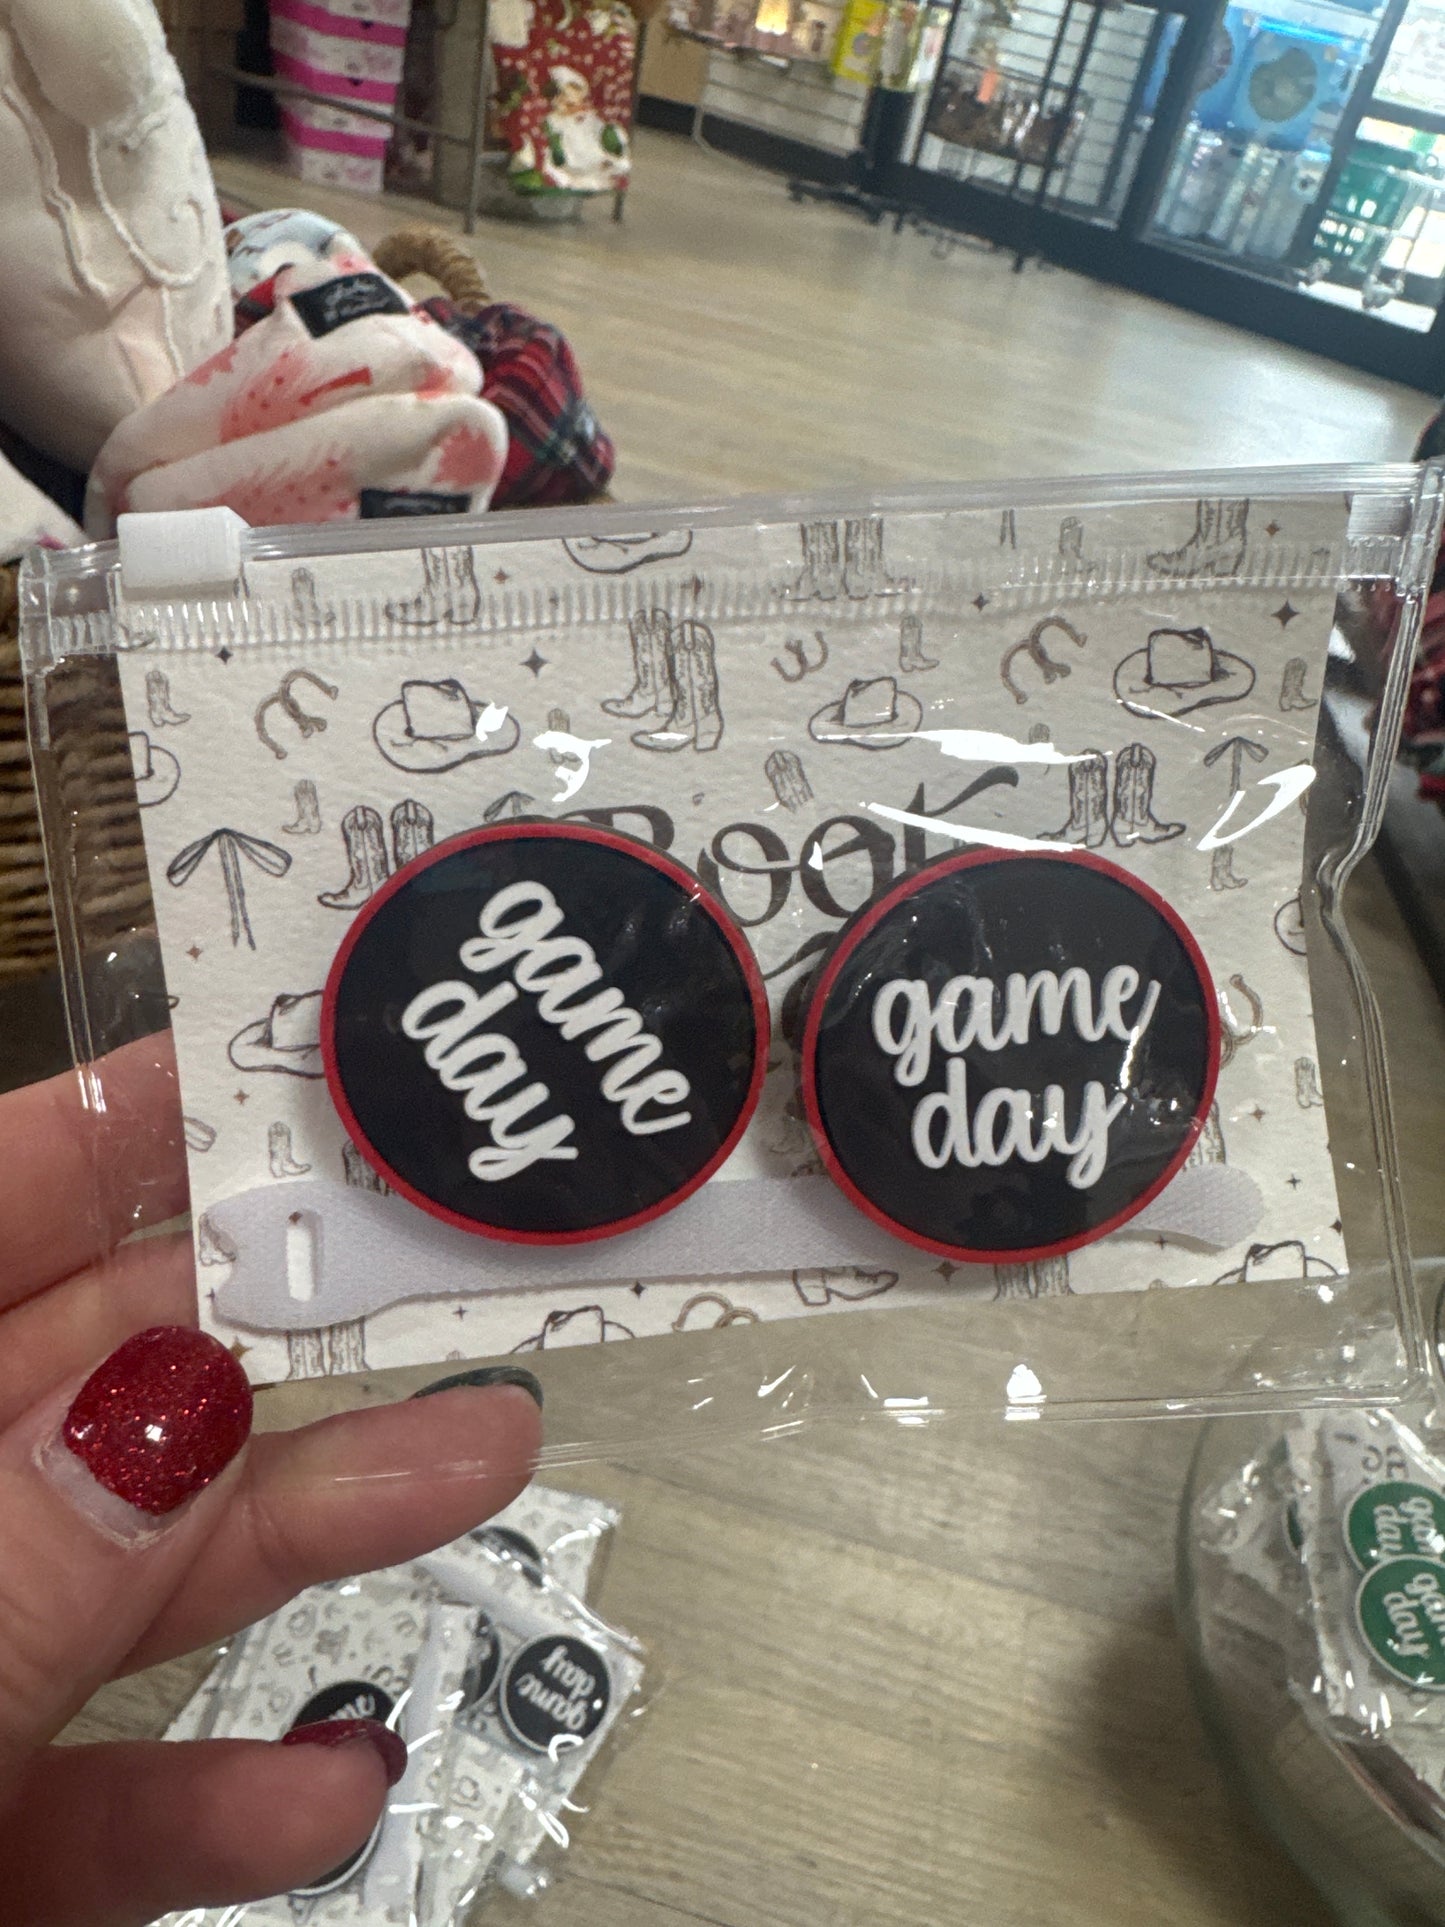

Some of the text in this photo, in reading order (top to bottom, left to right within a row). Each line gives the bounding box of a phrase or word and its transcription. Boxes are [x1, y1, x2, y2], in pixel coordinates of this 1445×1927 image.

[558, 765, 1019, 927] oot
[459, 881, 692, 1135] game
[872, 964, 1162, 1087] game
[402, 980, 579, 1182] day
[911, 1057, 1128, 1190] day
[1400, 1496, 1440, 1555] ga
[1382, 1592, 1430, 1659] day
[1404, 1573, 1445, 1646] ga
[514, 1672, 588, 1731] game
[541, 1644, 596, 1700] day
